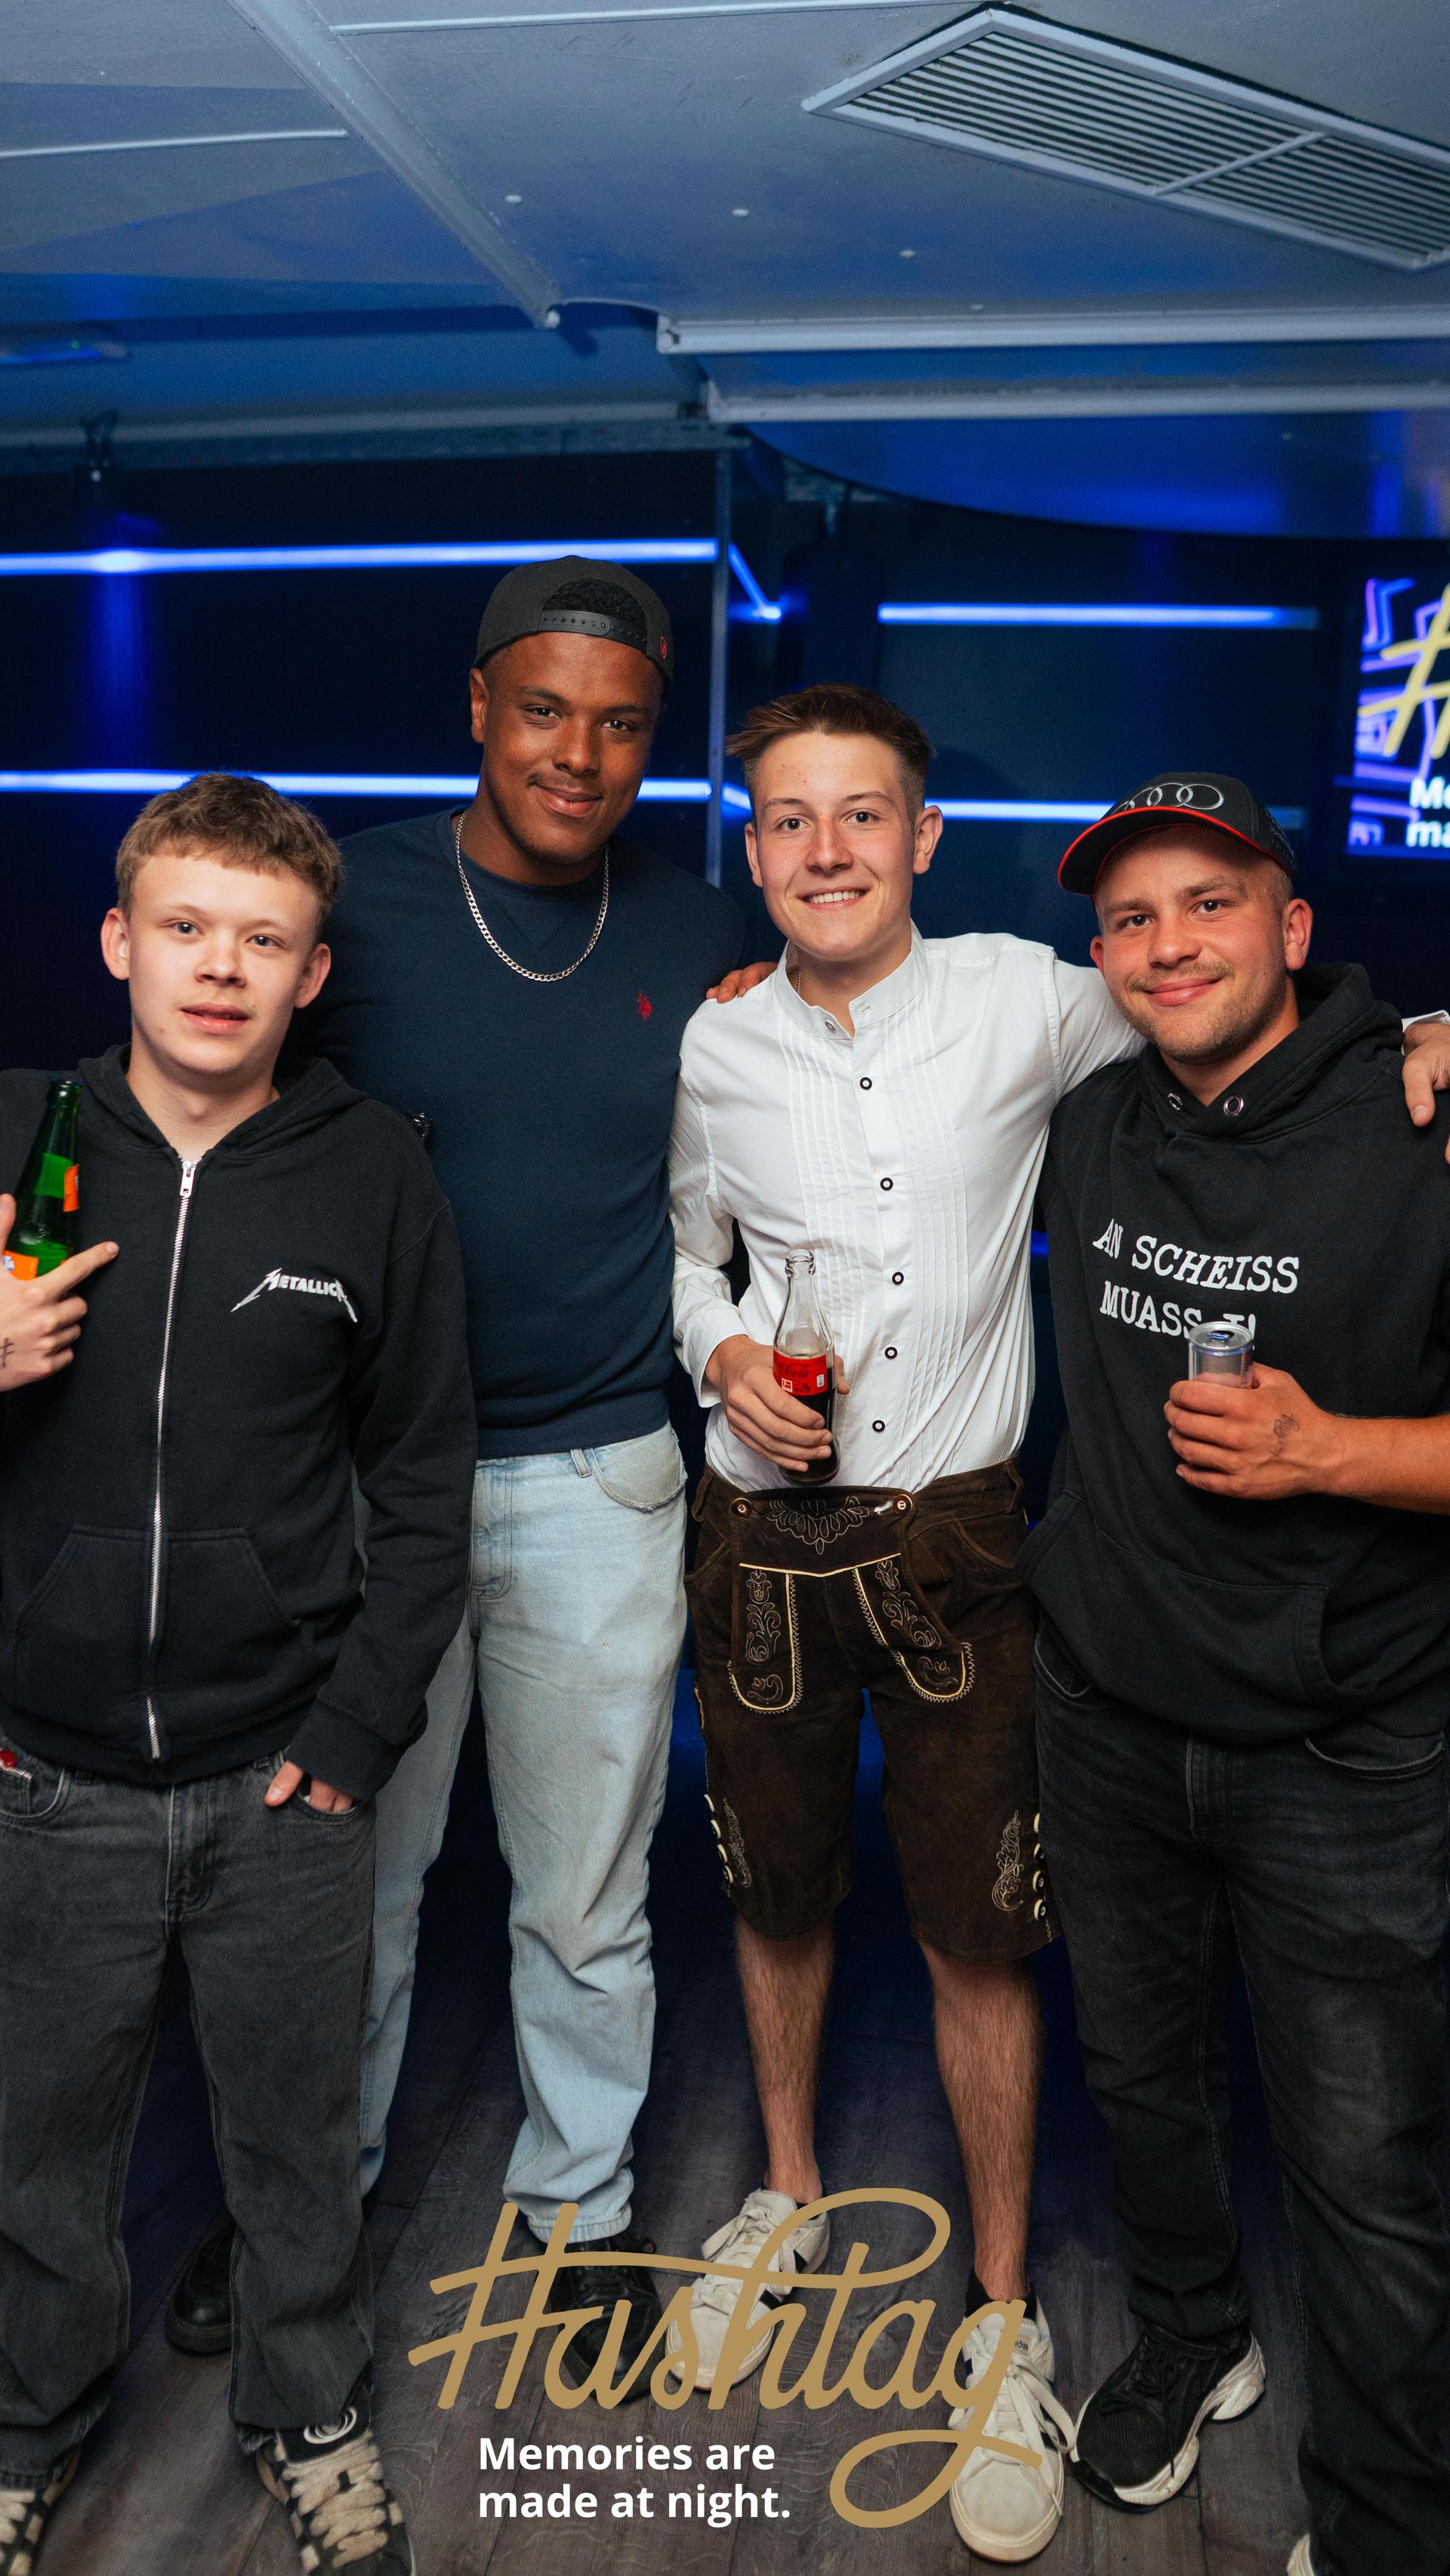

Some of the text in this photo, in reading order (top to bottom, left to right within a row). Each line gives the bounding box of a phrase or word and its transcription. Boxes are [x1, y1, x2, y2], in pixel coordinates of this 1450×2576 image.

[1093, 1218, 1300, 1294] AN SCHEISS
[230, 1267, 358, 1323] METALLICA
